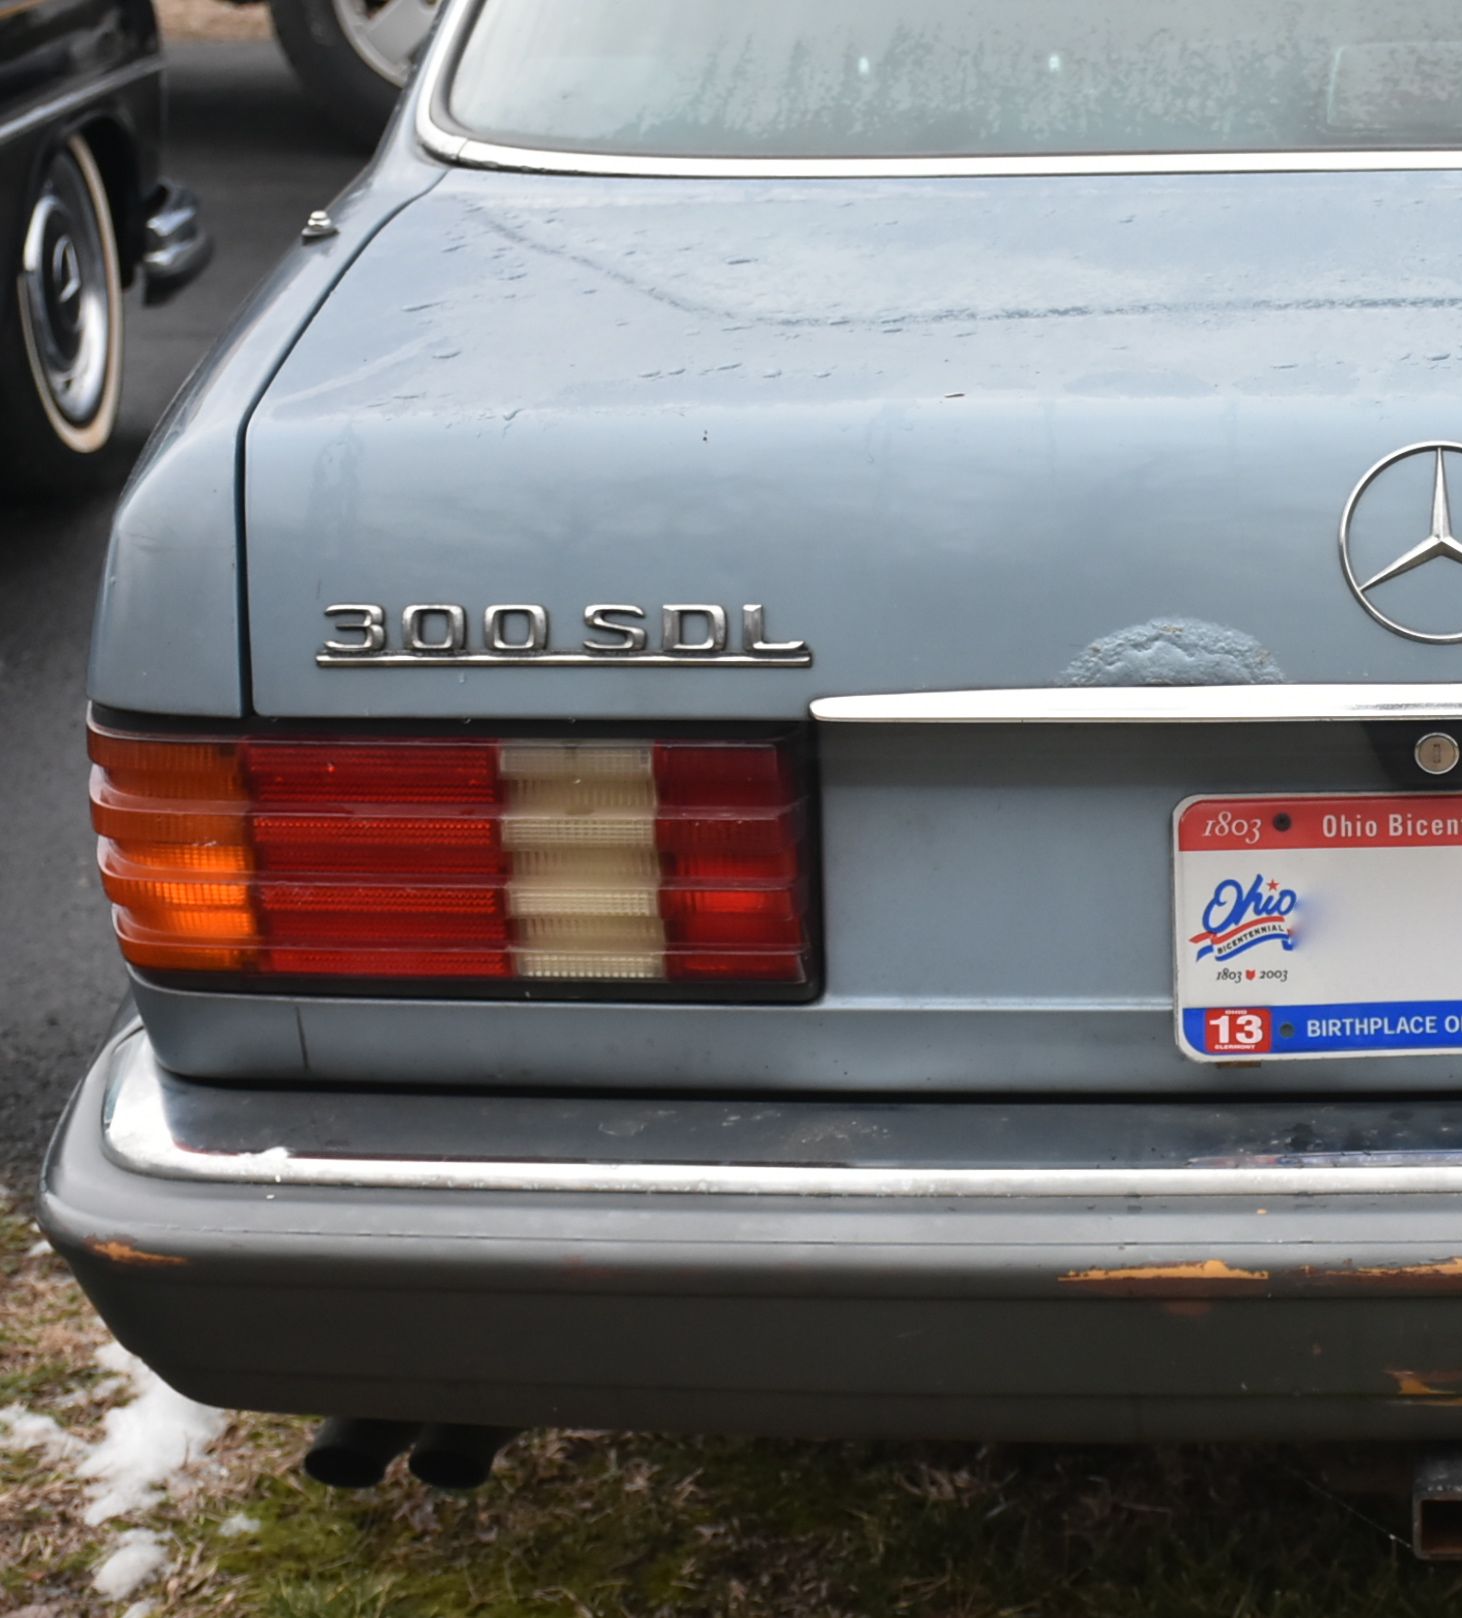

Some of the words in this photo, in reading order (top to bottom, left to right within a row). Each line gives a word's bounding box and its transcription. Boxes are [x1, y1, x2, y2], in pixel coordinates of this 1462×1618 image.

[323, 603, 549, 652] 300
[582, 603, 806, 652] SDL
[1202, 811, 1262, 845] 1803
[1322, 814, 1378, 838] Ohio
[1202, 873, 1297, 934] Ohio
[1217, 924, 1285, 955] BICENTENNIAL
[1216, 967, 1242, 984] 1803
[1259, 969, 1288, 983] 2003
[1209, 1014, 1264, 1044] 13
[1307, 1015, 1437, 1038] BIRTHPLACE
